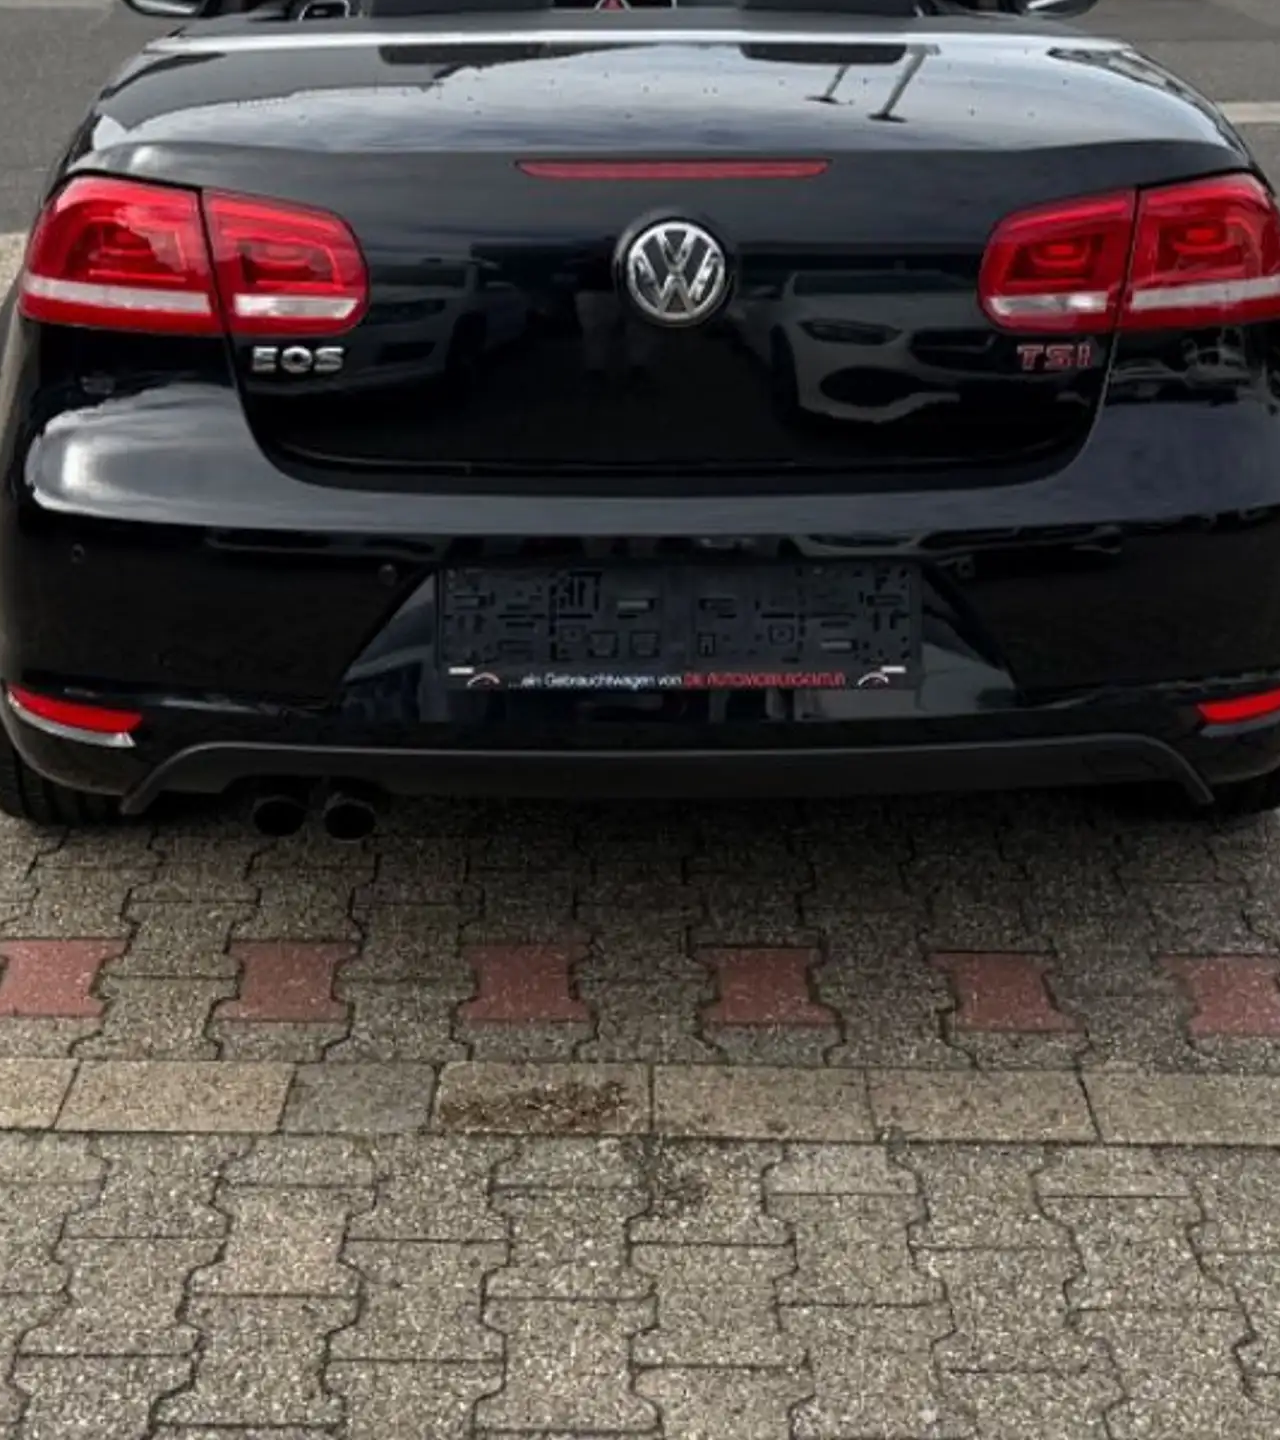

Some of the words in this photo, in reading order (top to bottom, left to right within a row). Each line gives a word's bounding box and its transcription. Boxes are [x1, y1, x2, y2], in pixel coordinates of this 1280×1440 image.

[252, 346, 344, 373] EOS
[544, 672, 655, 691] Gebrauchtwagen
[658, 674, 683, 687] von
